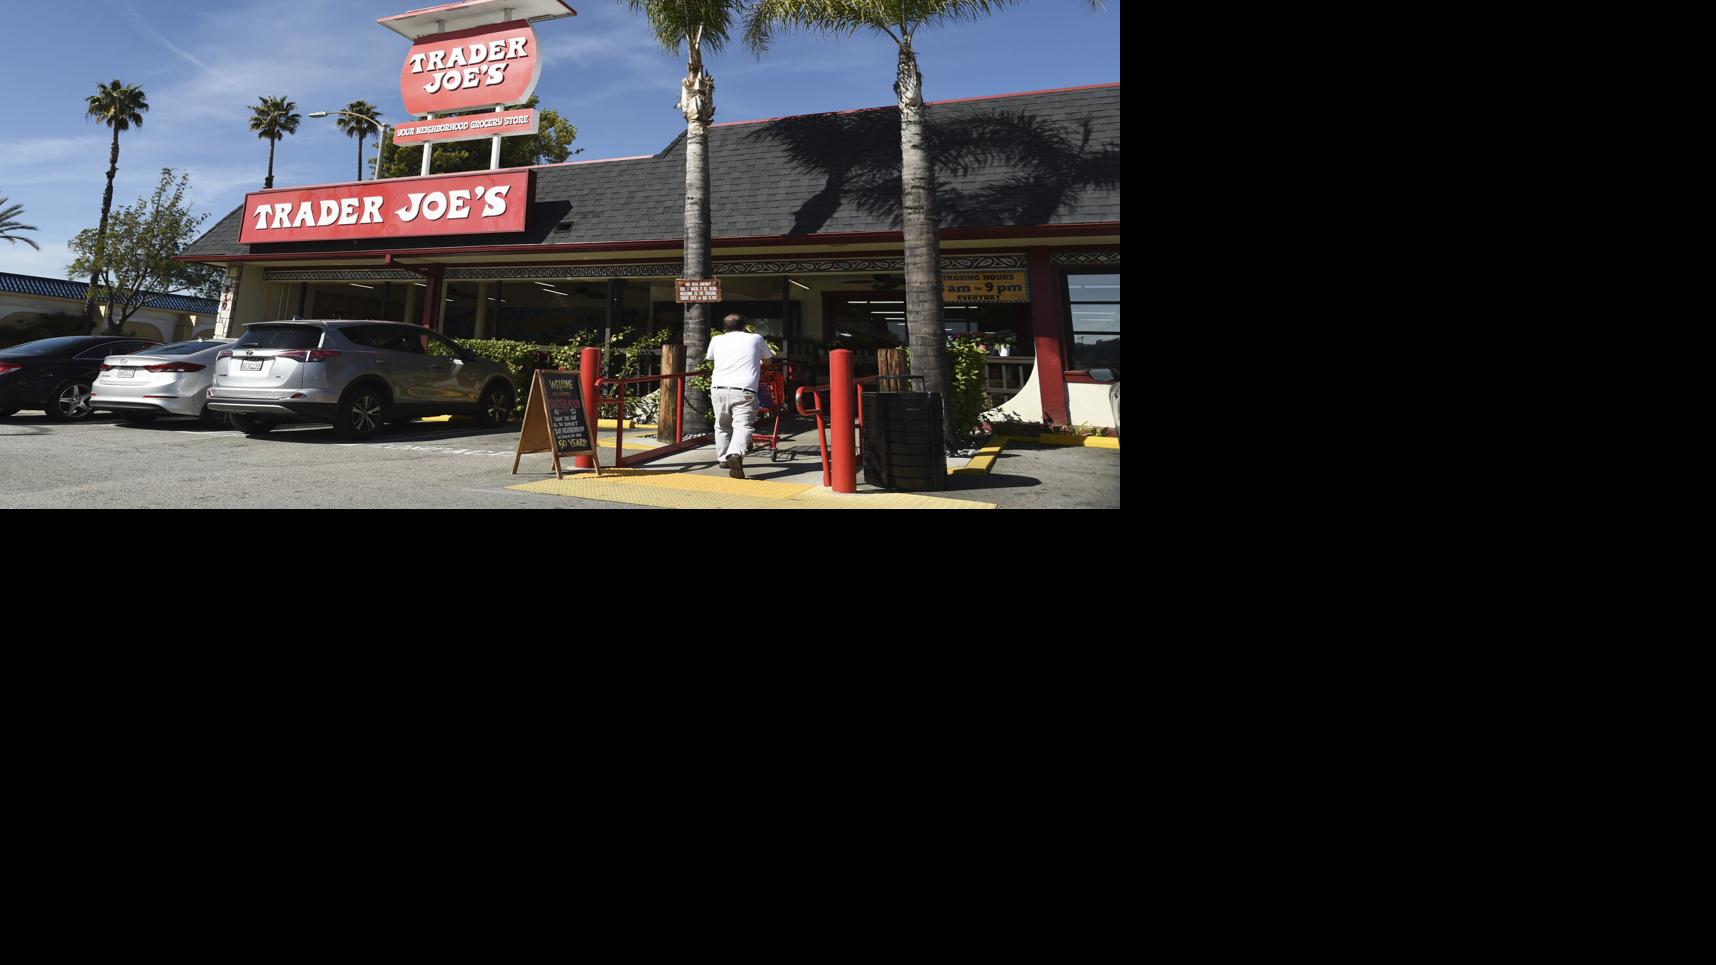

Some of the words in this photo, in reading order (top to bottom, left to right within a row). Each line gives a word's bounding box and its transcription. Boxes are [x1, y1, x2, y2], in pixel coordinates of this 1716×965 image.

[409, 36, 529, 74] TRADER
[422, 62, 509, 94] JOE'S
[396, 127, 415, 137] YOUR
[416, 121, 469, 135] NEIGHBORHOOD
[470, 117, 503, 129] GROCERY
[504, 115, 529, 125] STORE
[253, 195, 384, 230] TRADER
[393, 185, 511, 223] JOE'S
[947, 285, 971, 293] am
[985, 281, 994, 292] 9
[997, 284, 1023, 294] pm
[983, 273, 1014, 281] HOURS
